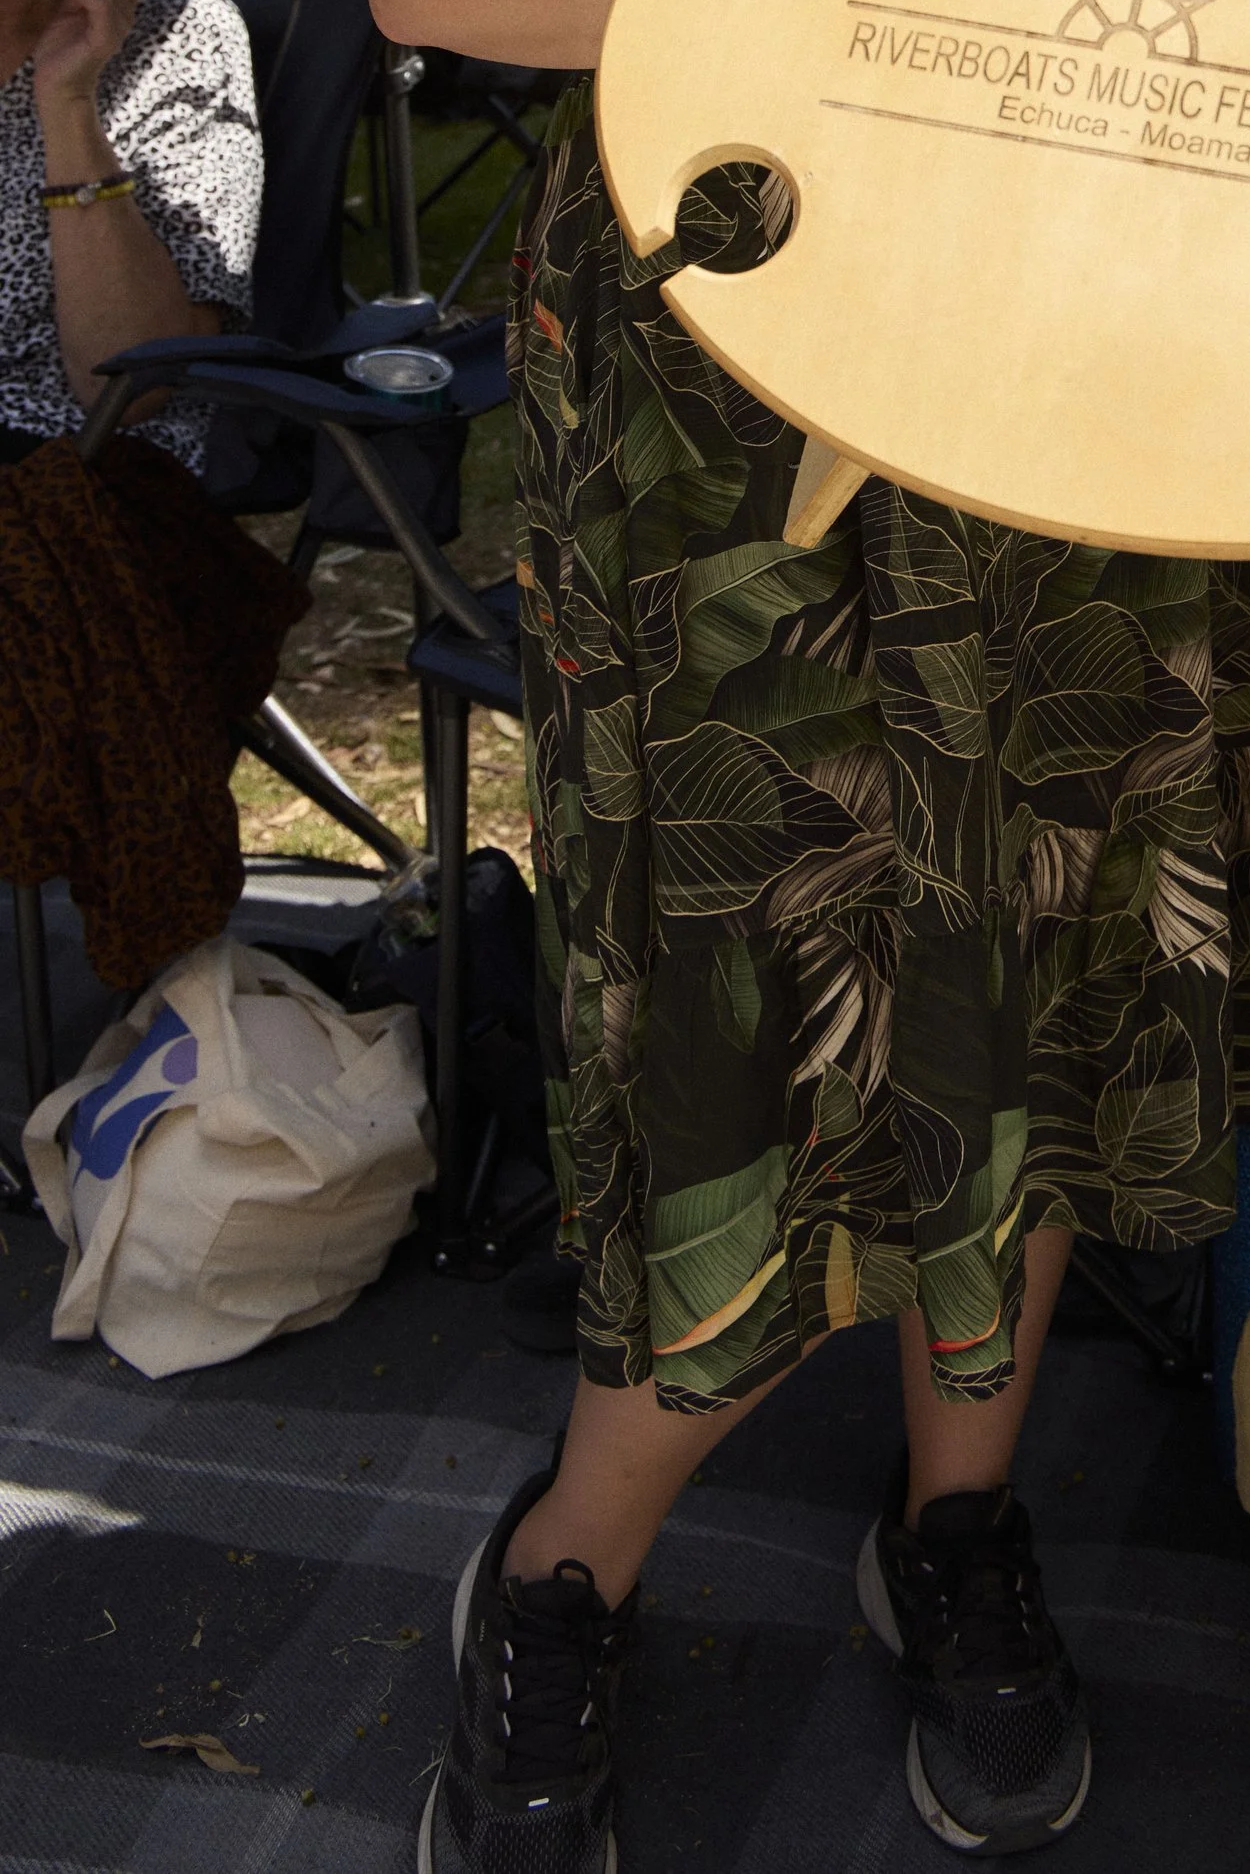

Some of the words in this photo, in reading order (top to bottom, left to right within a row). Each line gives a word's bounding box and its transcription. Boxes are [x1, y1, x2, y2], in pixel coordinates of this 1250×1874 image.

[848, 20, 1079, 97] RIVERBOATS
[1087, 62, 1206, 120] MUSIC
[997, 94, 1109, 138] Echuca
